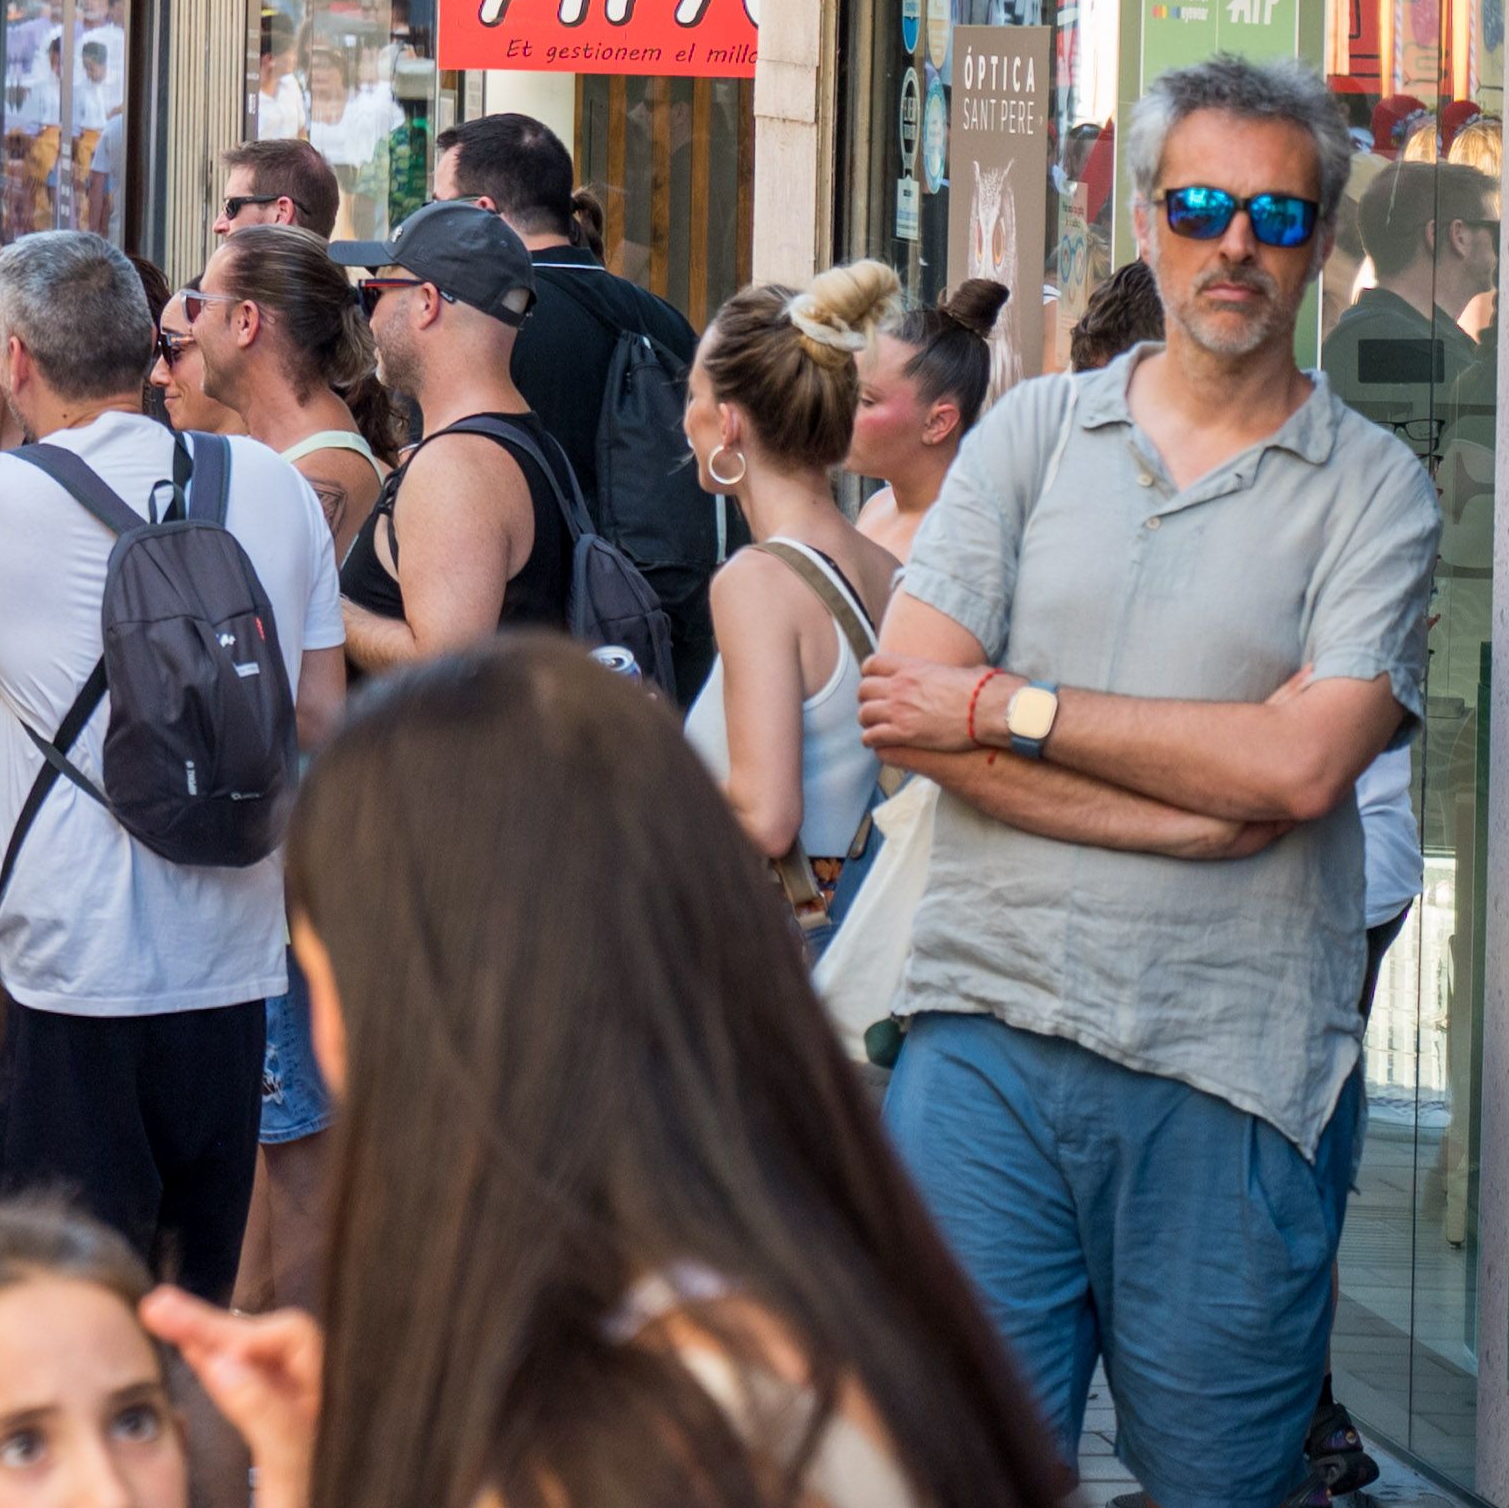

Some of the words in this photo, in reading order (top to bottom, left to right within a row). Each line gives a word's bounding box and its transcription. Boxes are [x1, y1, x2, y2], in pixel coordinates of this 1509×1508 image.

[506, 39, 533, 58] Et
[546, 41, 662, 63] gestionem
[675, 44, 695, 63] el
[963, 46, 1036, 93] ÓPTICA
[962, 97, 997, 131] SANT
[1000, 100, 1035, 135] PERE
